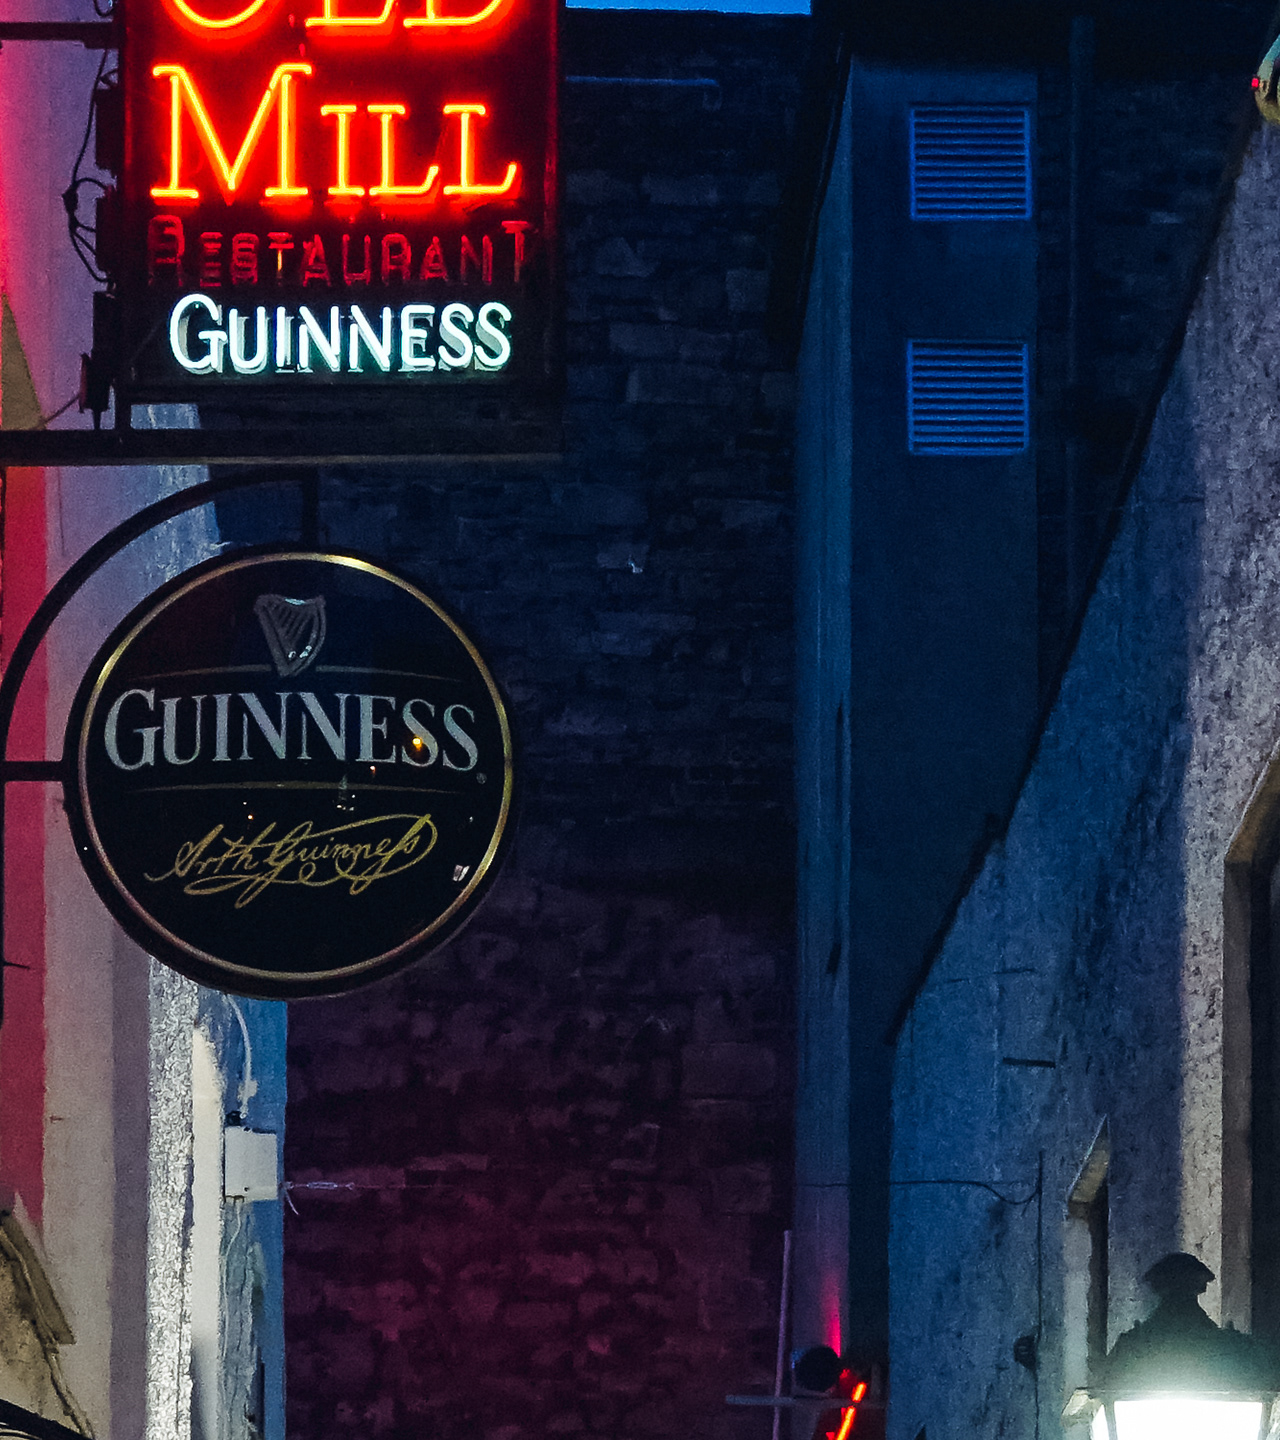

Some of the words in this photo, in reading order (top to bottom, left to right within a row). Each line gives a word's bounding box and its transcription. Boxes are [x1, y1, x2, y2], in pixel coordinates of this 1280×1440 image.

[150, 63, 517, 201] MILL
[147, 215, 533, 288] RESTAURANT
[169, 293, 513, 375] GUINNESS
[103, 687, 479, 772] GUINNESS
